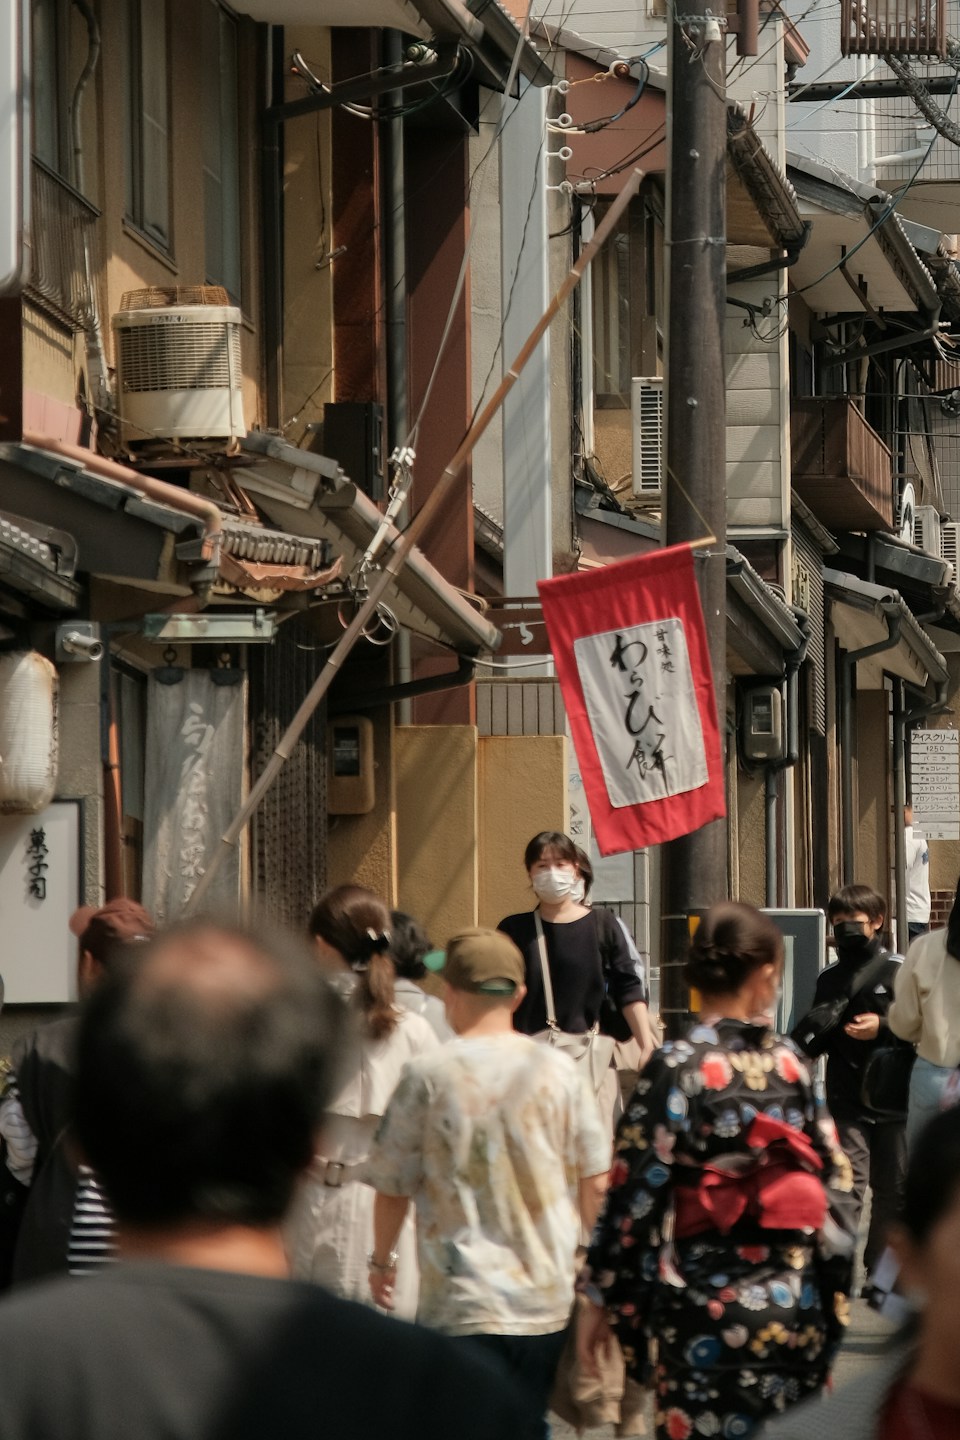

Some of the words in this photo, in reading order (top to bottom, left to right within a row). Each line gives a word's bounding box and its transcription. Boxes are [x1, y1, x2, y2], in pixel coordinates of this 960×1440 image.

[654, 628, 675, 674] 甘味処
[609, 634, 674, 797] わらび餅
[912, 733, 958, 743] アイスクリーム
